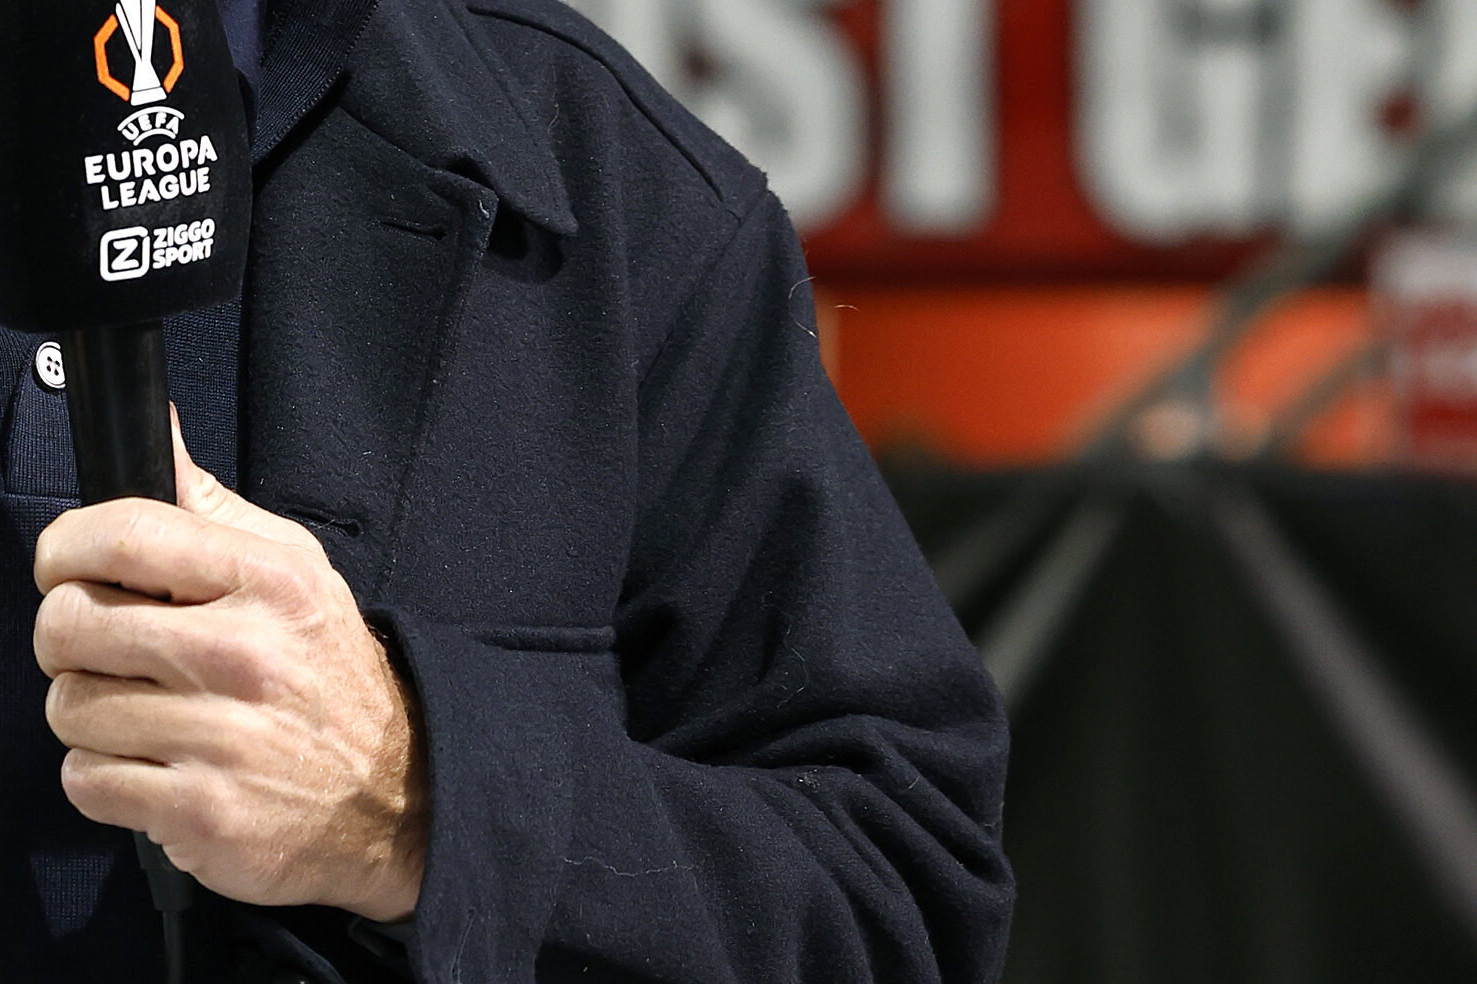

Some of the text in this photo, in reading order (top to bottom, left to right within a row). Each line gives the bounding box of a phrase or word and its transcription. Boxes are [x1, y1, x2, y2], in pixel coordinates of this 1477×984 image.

[121, 112, 180, 141] UEFA
[84, 135, 218, 184] EUROPA
[100, 166, 211, 210] LEAGUE
[153, 218, 216, 249] ZIGGO
[152, 238, 214, 269] SPORT
